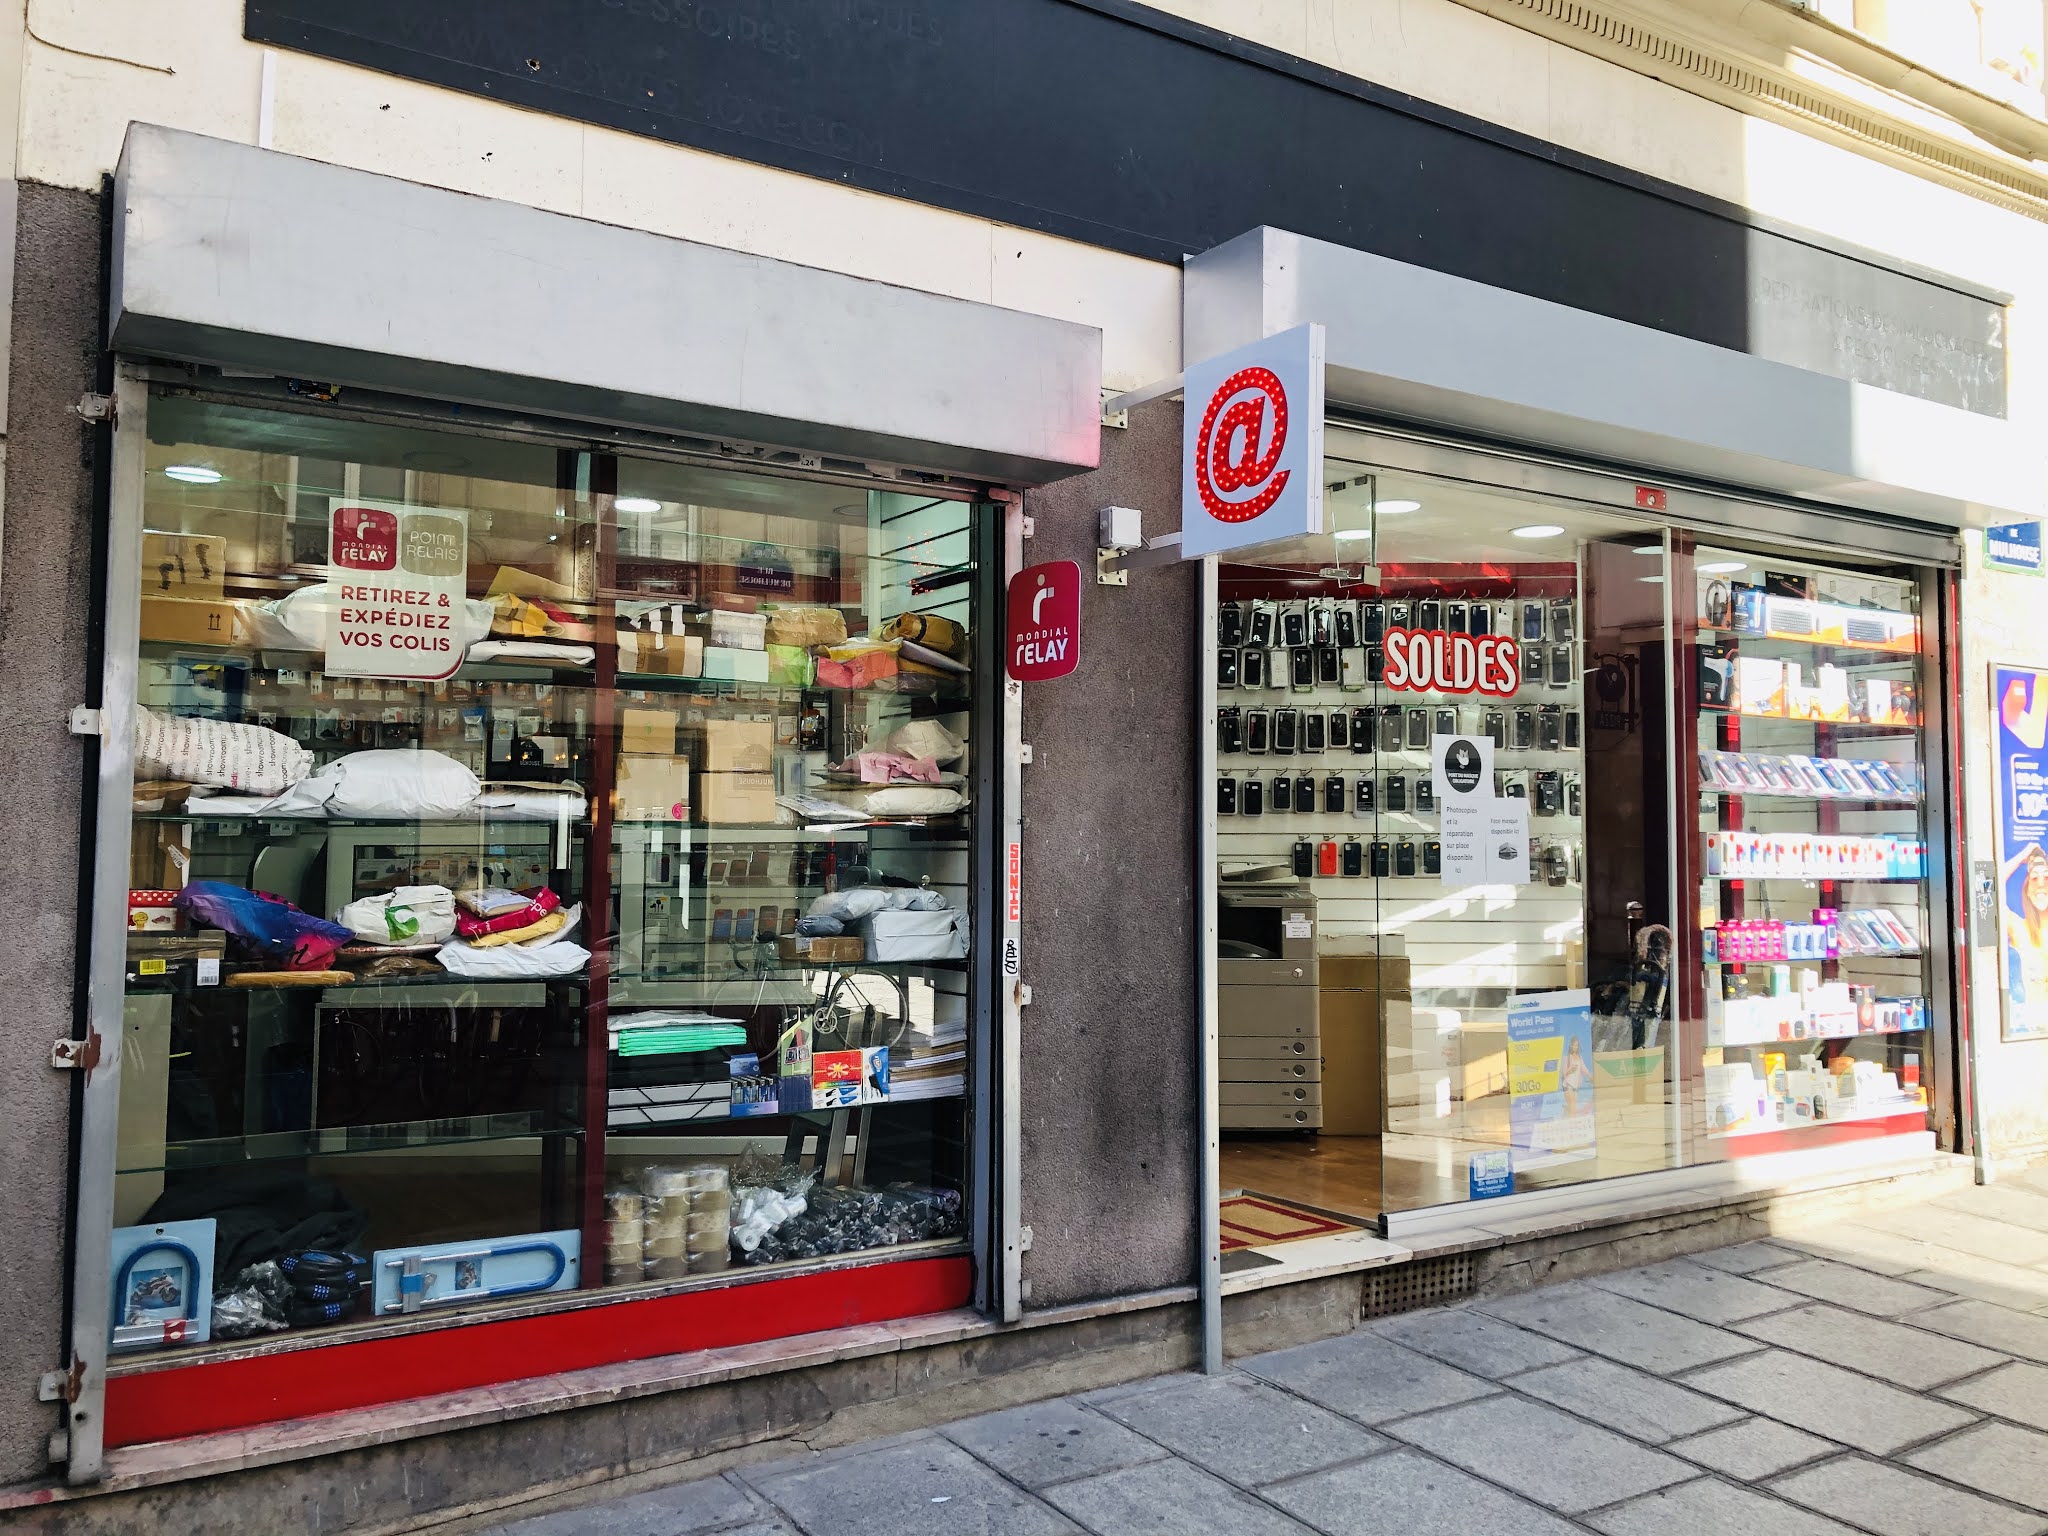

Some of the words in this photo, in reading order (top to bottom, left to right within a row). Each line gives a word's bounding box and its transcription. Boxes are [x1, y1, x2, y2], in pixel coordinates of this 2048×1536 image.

[410, 531, 456, 547] POINT
[406, 544, 458, 561] RELAIS
[341, 585, 430, 606] RETIREZ
[437, 593, 450, 608] &
[340, 608, 450, 630] EXPÉDIEZ
[339, 631, 383, 648] VOS
[389, 633, 451, 652] COLIS
[1386, 631, 1518, 694] SOLDES
[1446, 806, 1478, 815] Photocopies
[1455, 842, 1470, 850] place
[1446, 854, 1474, 862] disponible
[1009, 843, 1019, 921] SONIC
[1510, 1016, 1534, 1028] World
[1535, 1015, 1554, 1025] Pass
[1516, 1080, 1542, 1093] 30Go
